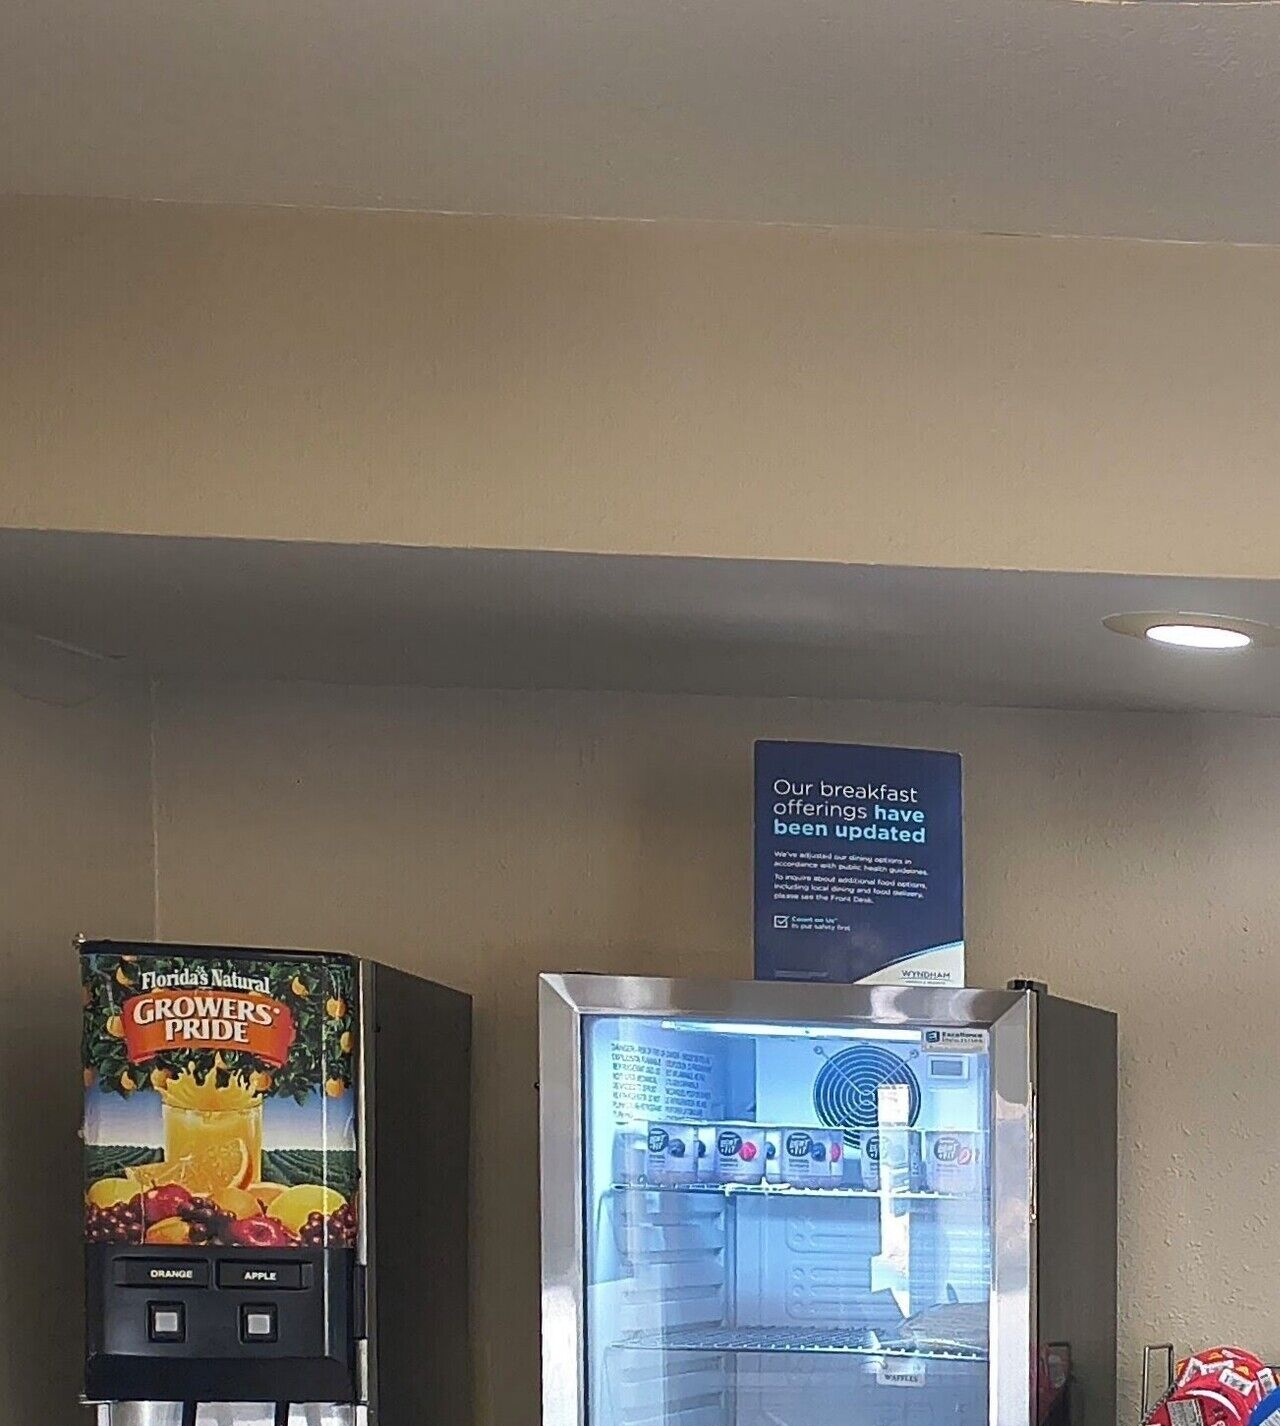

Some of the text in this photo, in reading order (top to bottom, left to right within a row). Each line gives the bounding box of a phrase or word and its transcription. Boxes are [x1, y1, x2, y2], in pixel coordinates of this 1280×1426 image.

[774, 779, 918, 802] Our breakfast
[774, 799, 924, 822] offerings have
[774, 819, 926, 843] been updated
[874, 857, 902, 865] options
[864, 865, 887, 873] health
[838, 877, 876, 885] additional
[774, 884, 809, 892] including
[902, 970, 950, 978] WYNDHAM
[211, 969, 270, 994] Natural
[165, 1018, 249, 1042] PRIDE
[150, 1270, 193, 1278] ORANGE
[244, 1272, 277, 1280] APPLE
